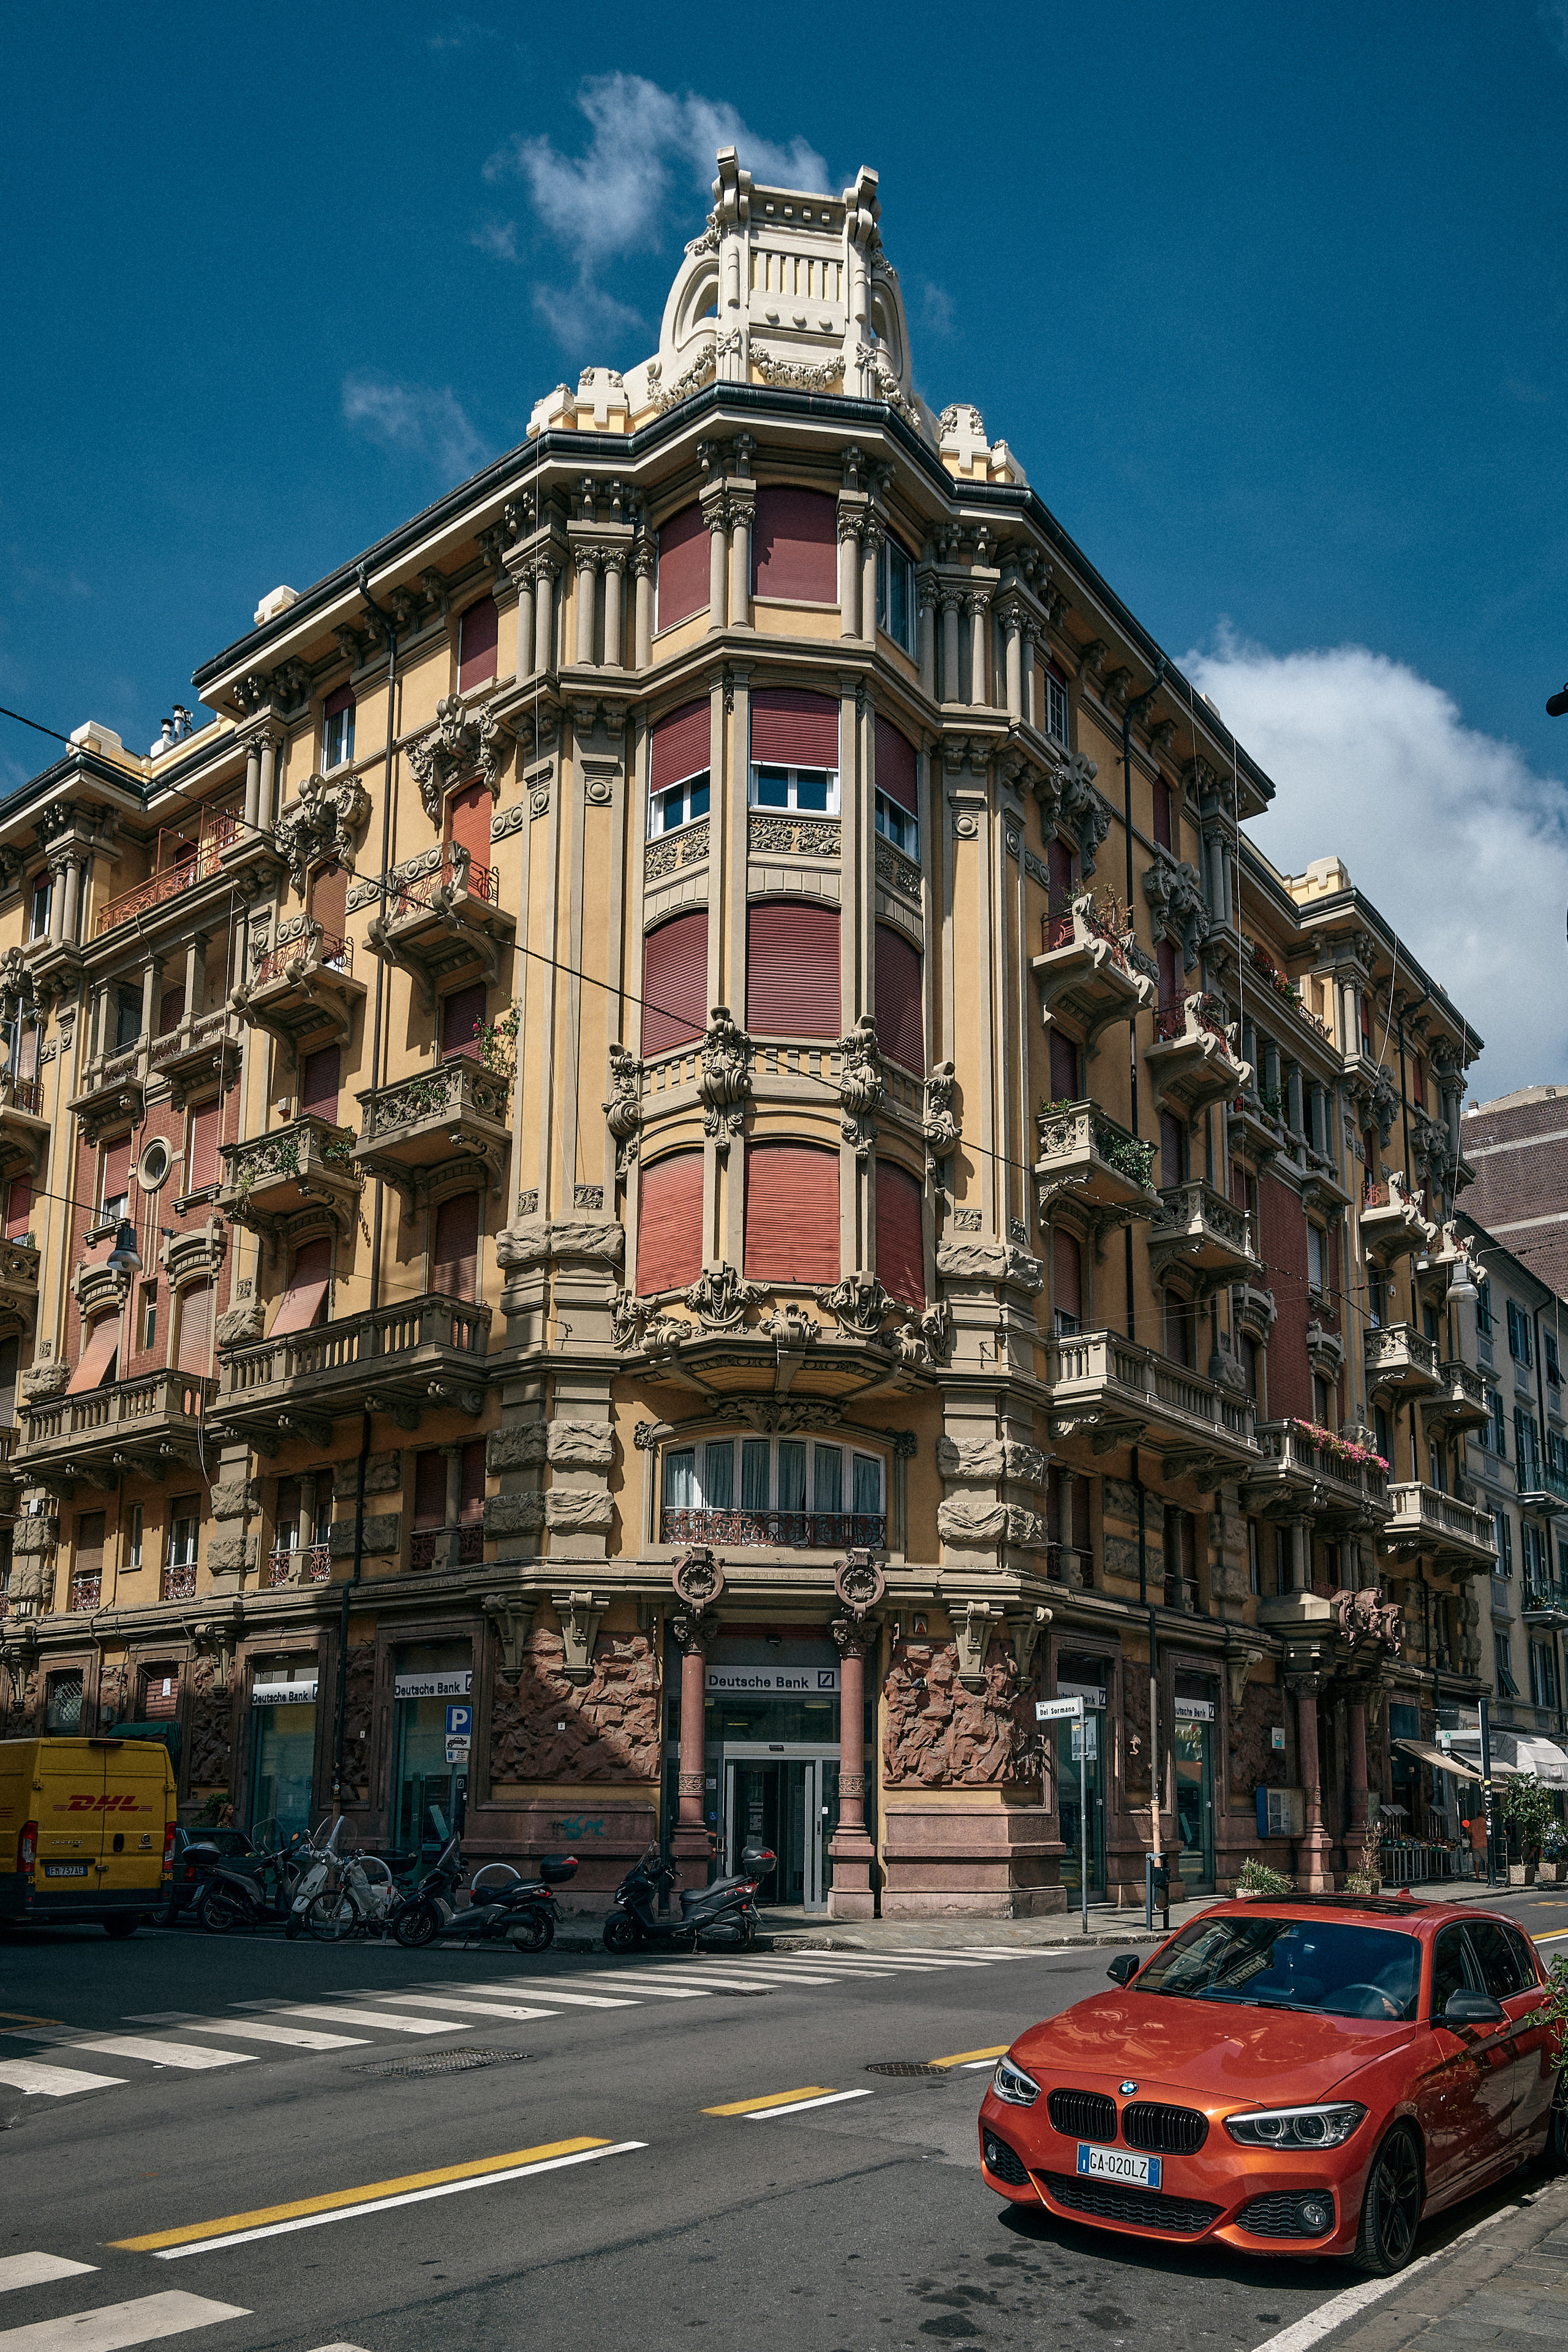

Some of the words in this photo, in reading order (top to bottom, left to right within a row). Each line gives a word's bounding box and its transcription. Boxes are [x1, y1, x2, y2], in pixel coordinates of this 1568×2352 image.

[395, 1683, 434, 1695] Deutsche
[437, 1681, 460, 1693] Bank
[709, 1675, 771, 1687] Deutsche
[776, 1676, 809, 1689] Bank
[252, 1692, 287, 1703] Deutsche
[288, 1691, 308, 1702] Bank
[451, 1708, 468, 1731] P
[1194, 1708, 1206, 1718] Bank
[67, 1795, 140, 1811] DHL
